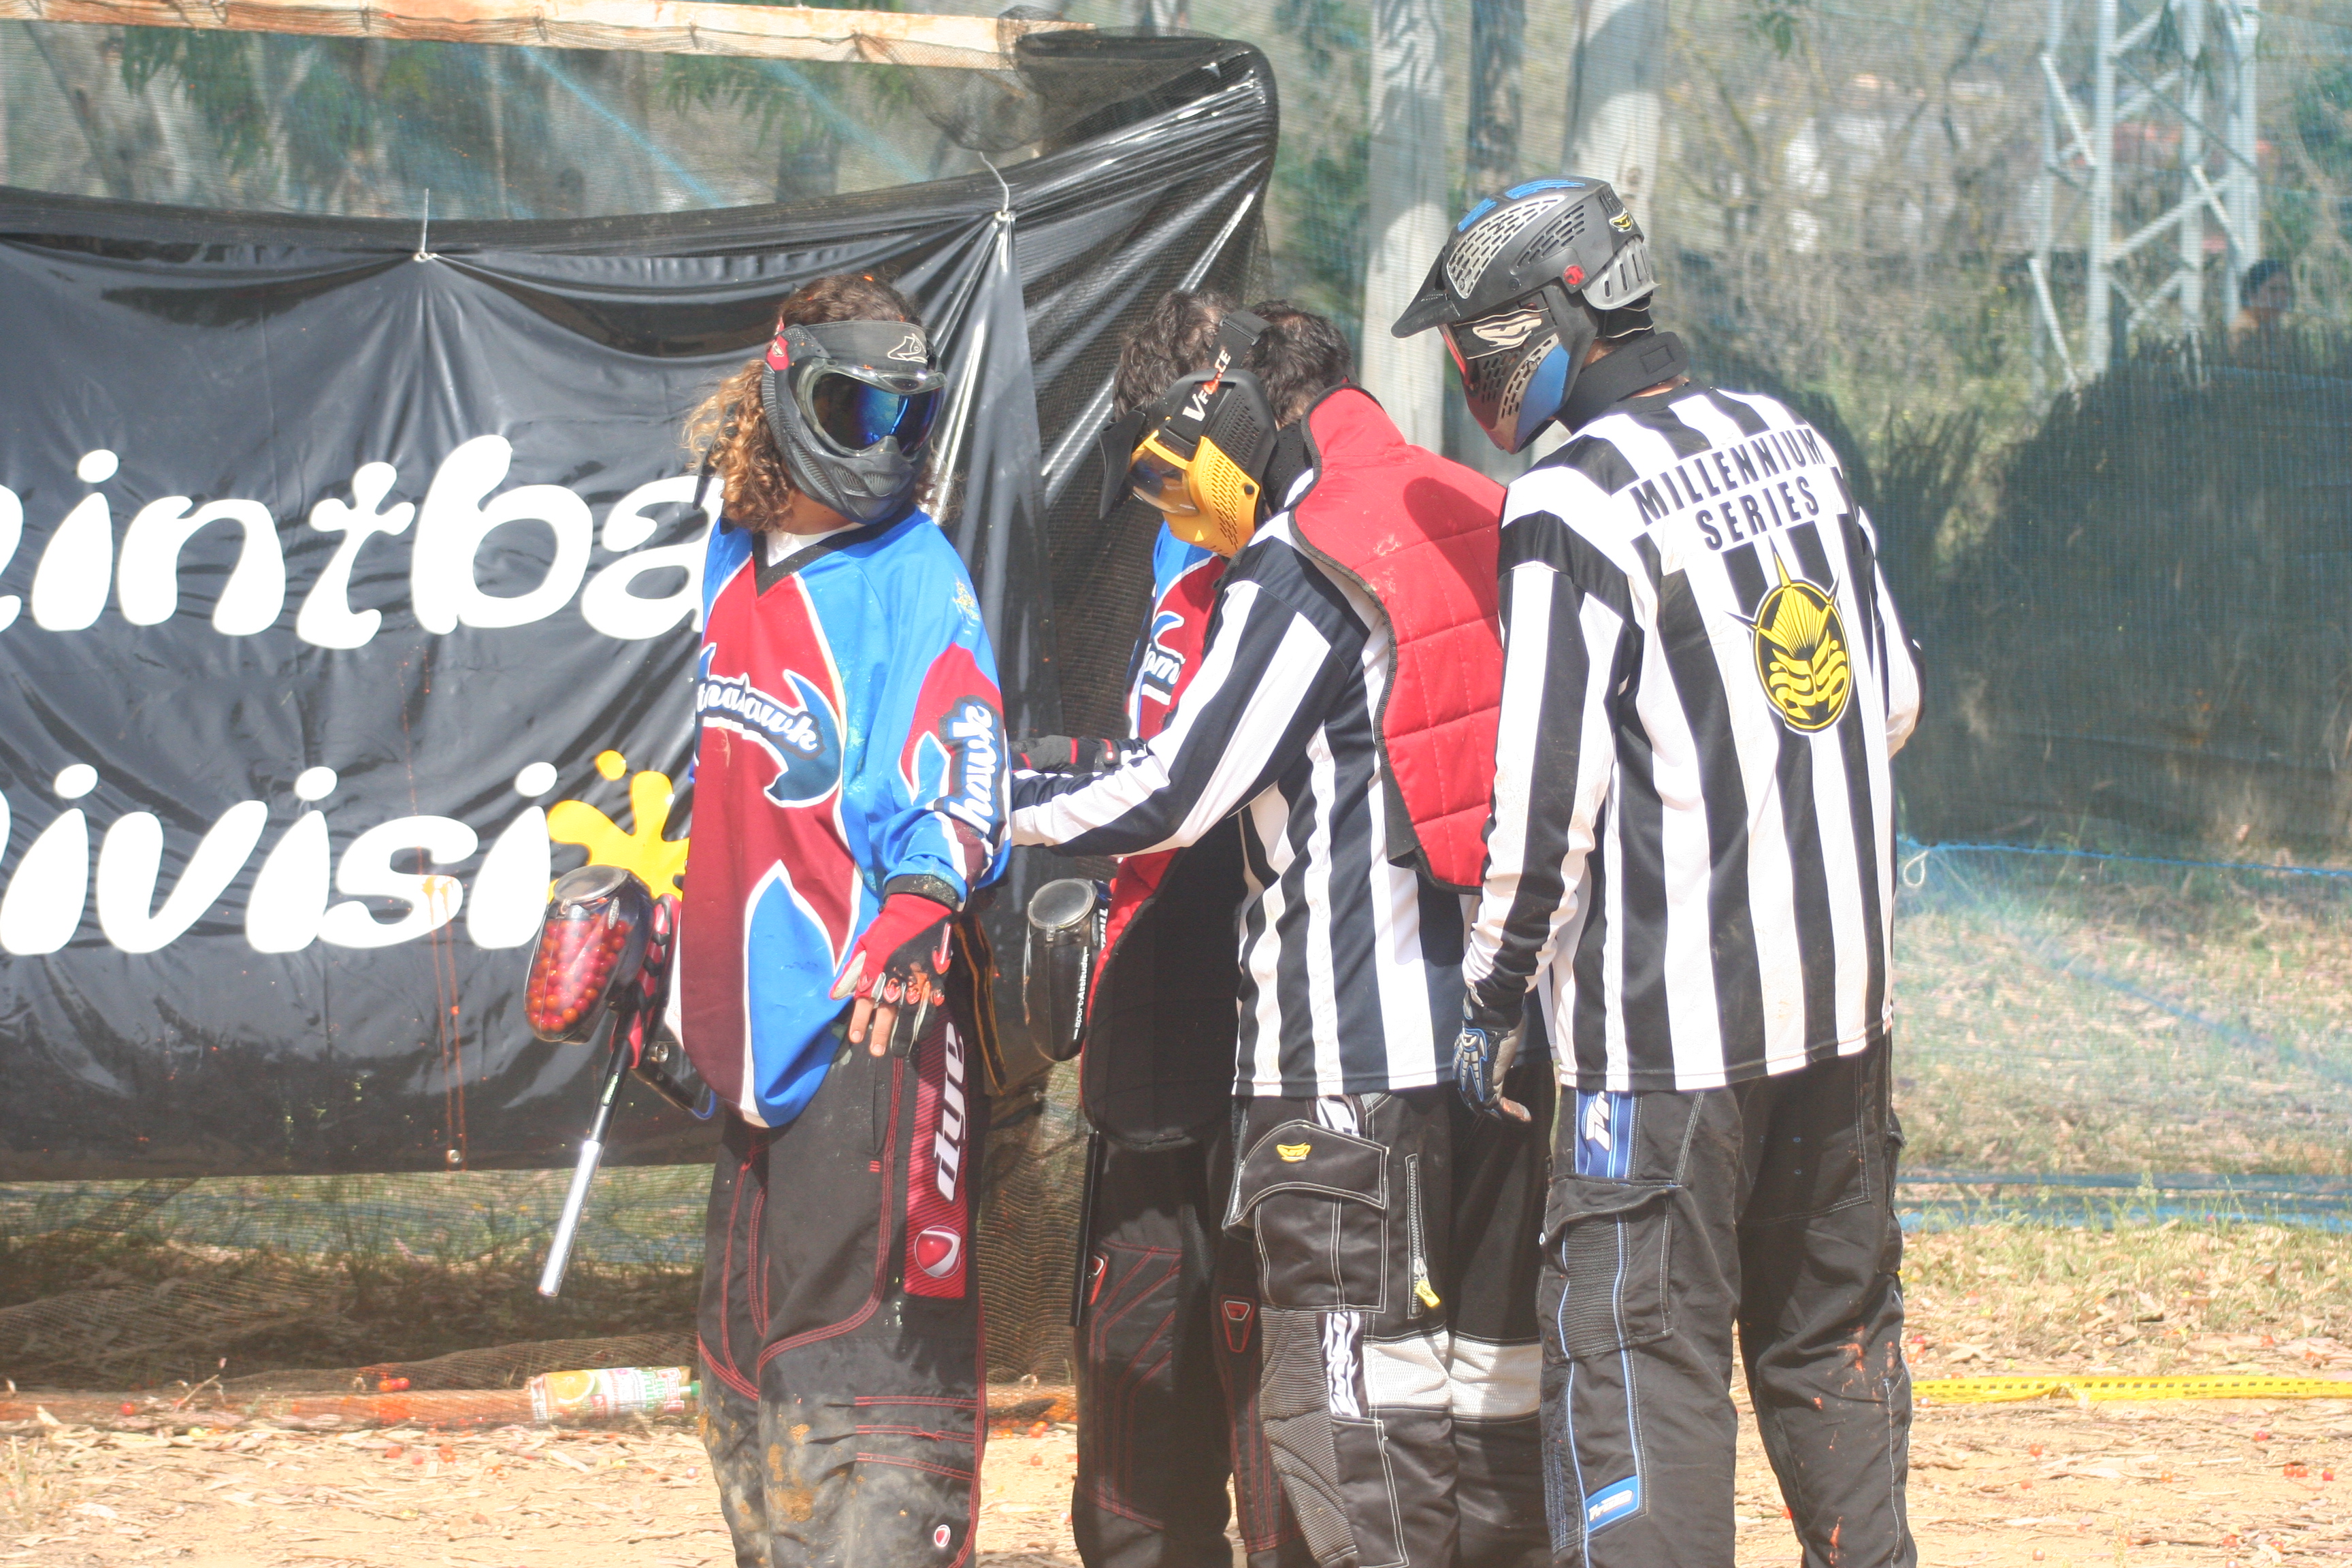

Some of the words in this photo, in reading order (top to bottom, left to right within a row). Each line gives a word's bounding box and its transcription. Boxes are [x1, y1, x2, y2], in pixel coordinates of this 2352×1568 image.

[1629, 425, 1829, 527] MILLENNIUM
[1695, 480, 1820, 551] SERIES
[949, 705, 997, 835] hawk
[0, 761, 557, 955] ivisi
[933, 1022, 968, 1201] dye
